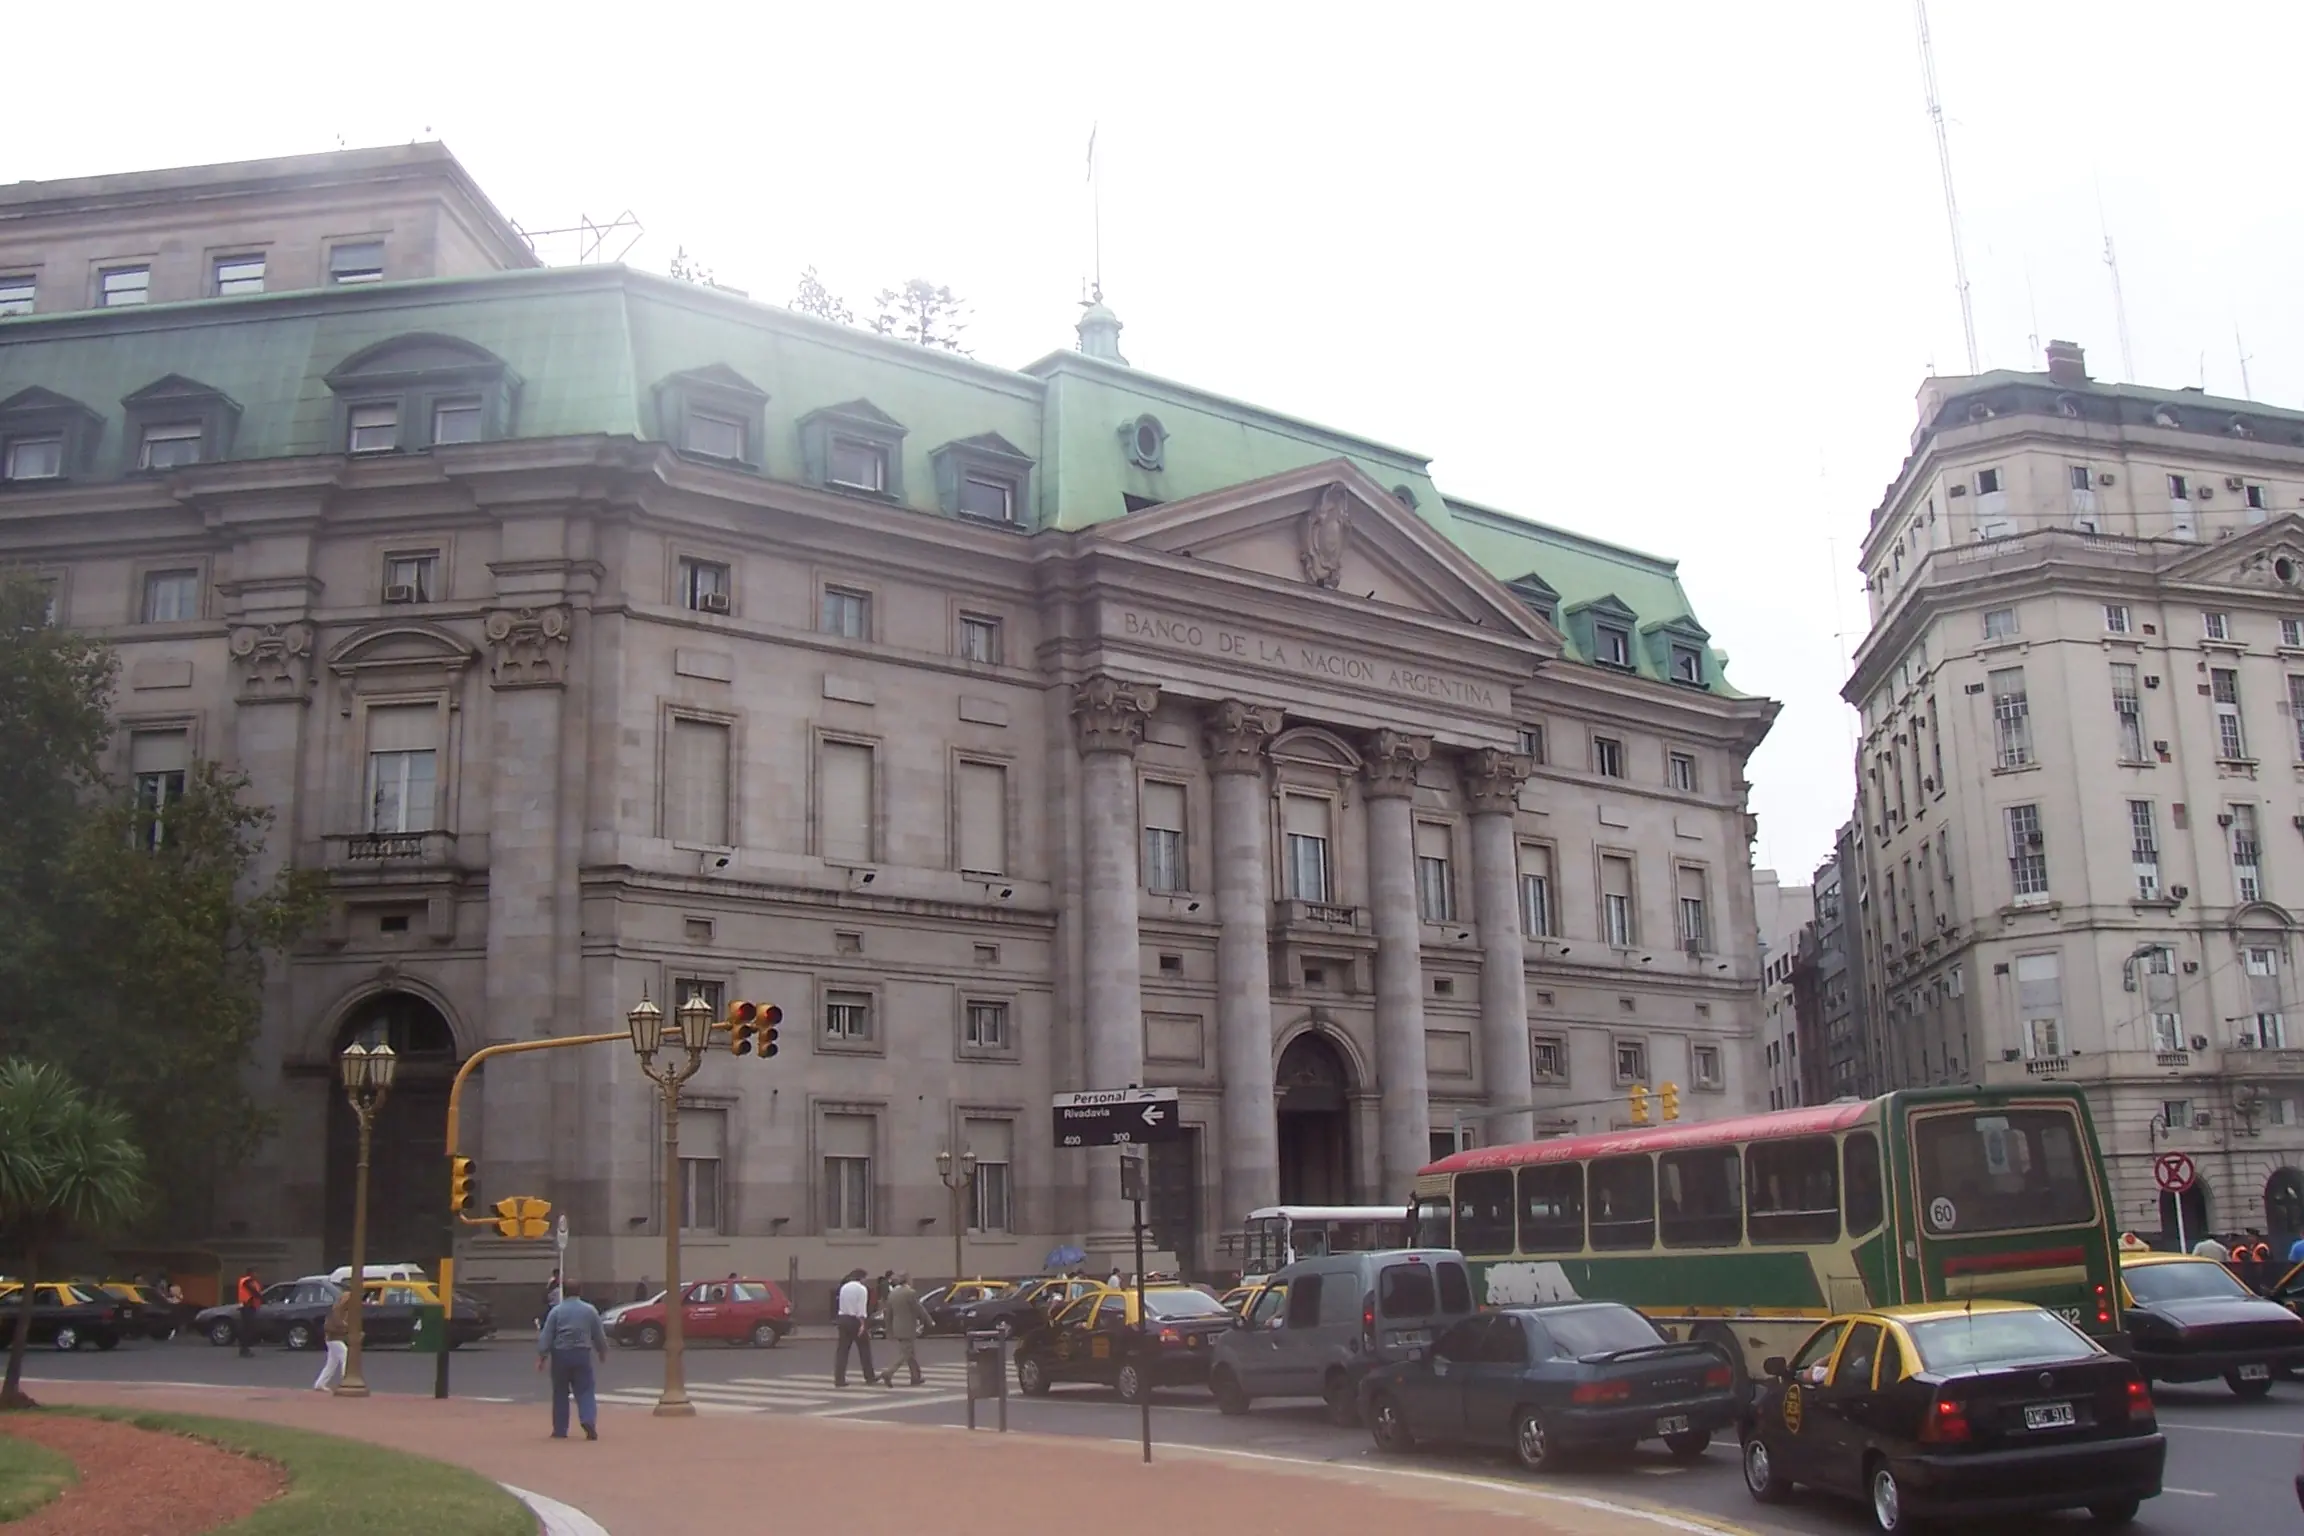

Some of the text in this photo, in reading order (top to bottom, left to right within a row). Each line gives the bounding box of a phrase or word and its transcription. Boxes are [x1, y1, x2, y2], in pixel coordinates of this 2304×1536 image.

[1125, 612, 1494, 709] BANCO DE LA NACION ARGENTINA
[1073, 1091, 1127, 1104] Personal
[1064, 1108, 1110, 1119] Rivadavia
[1064, 1132, 1130, 1145] 400 300
[1934, 1204, 1952, 1222] 60
